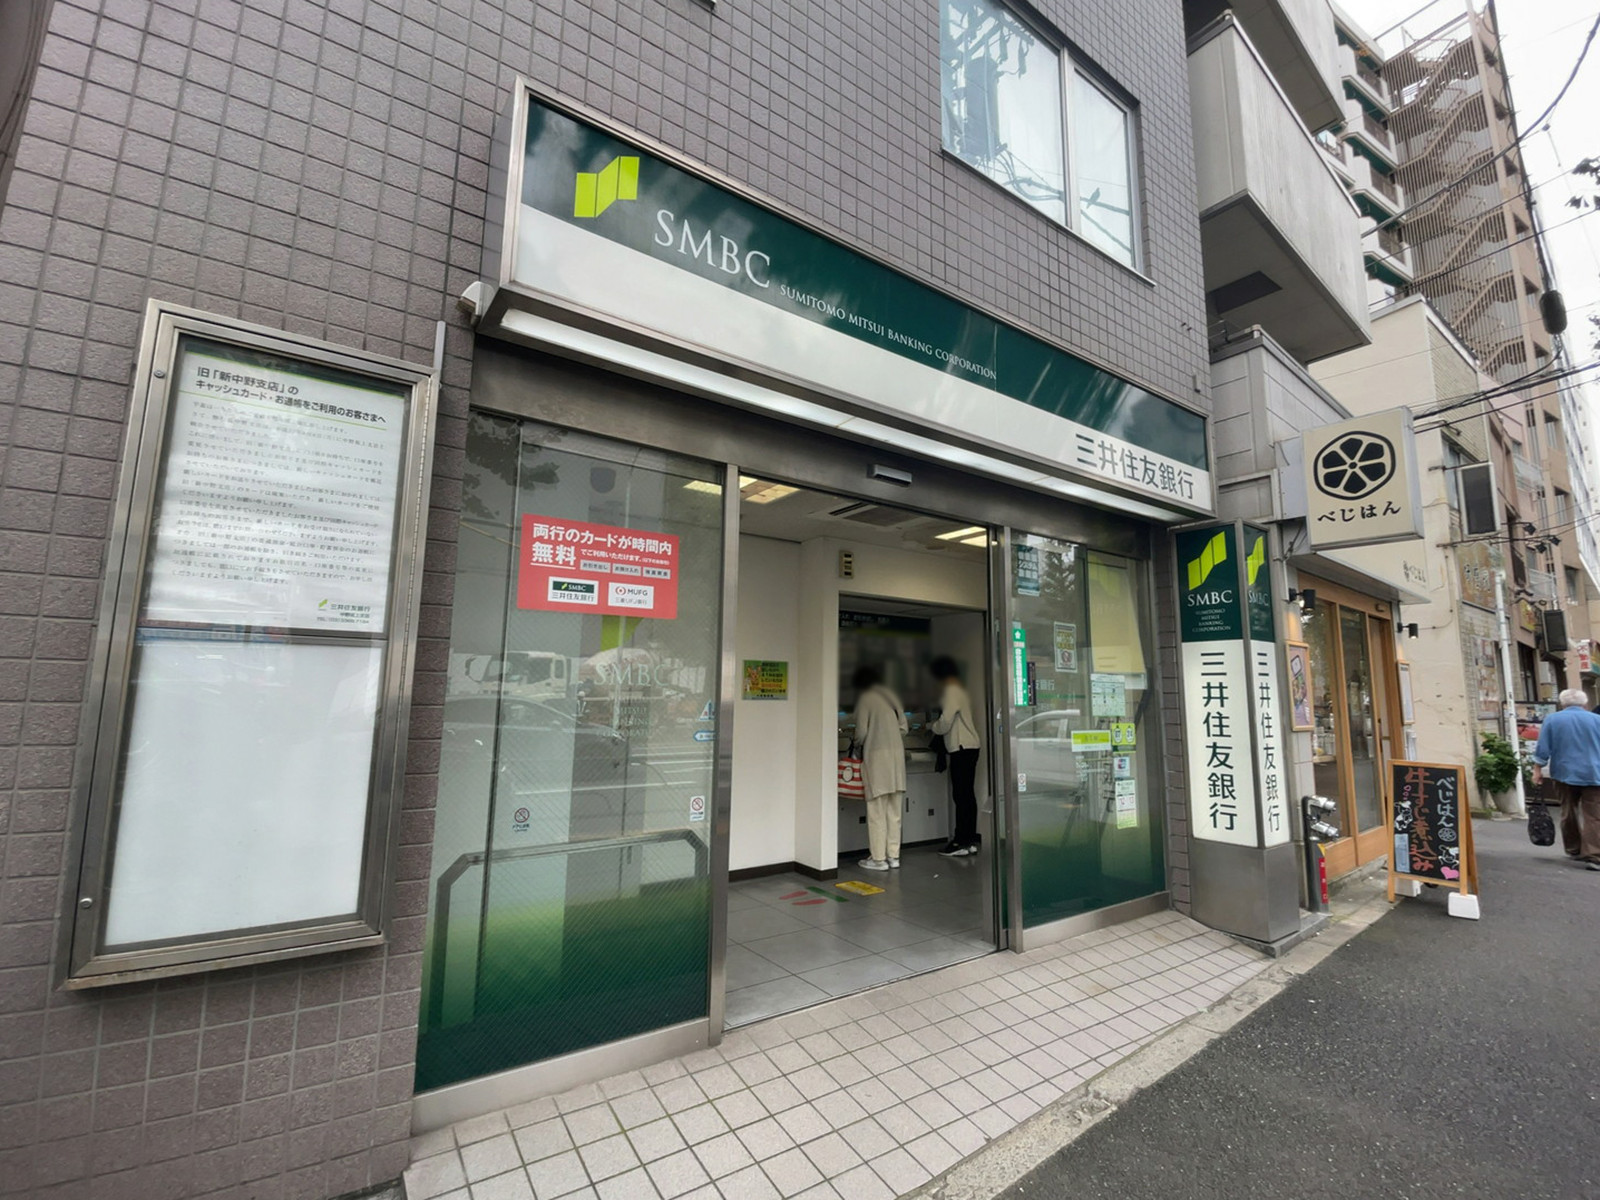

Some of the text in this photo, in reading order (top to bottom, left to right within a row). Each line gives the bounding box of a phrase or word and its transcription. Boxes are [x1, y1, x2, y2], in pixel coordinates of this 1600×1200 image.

[653, 209, 998, 381] SMBC SUMITOMO MITSUI BANKING CORPORATION
[1075, 433, 1196, 501] 三井住友銀行
[1317, 501, 1402, 522] べじはん
[532, 523, 672, 556] 両行のカードが時間内
[531, 541, 576, 566] 無料
[552, 592, 594, 602] 三井住友銀行
[568, 584, 586, 592] SMBC
[627, 588, 648, 597] MUFG
[1187, 590, 1233, 607] SMBC
[1248, 590, 1269, 606] SMBC
[594, 662, 669, 686] SMBC
[1201, 651, 1237, 831] 三井住友銀行
[1257, 652, 1281, 833] 三井住友銀行
[1436, 776, 1456, 828] べじはん
